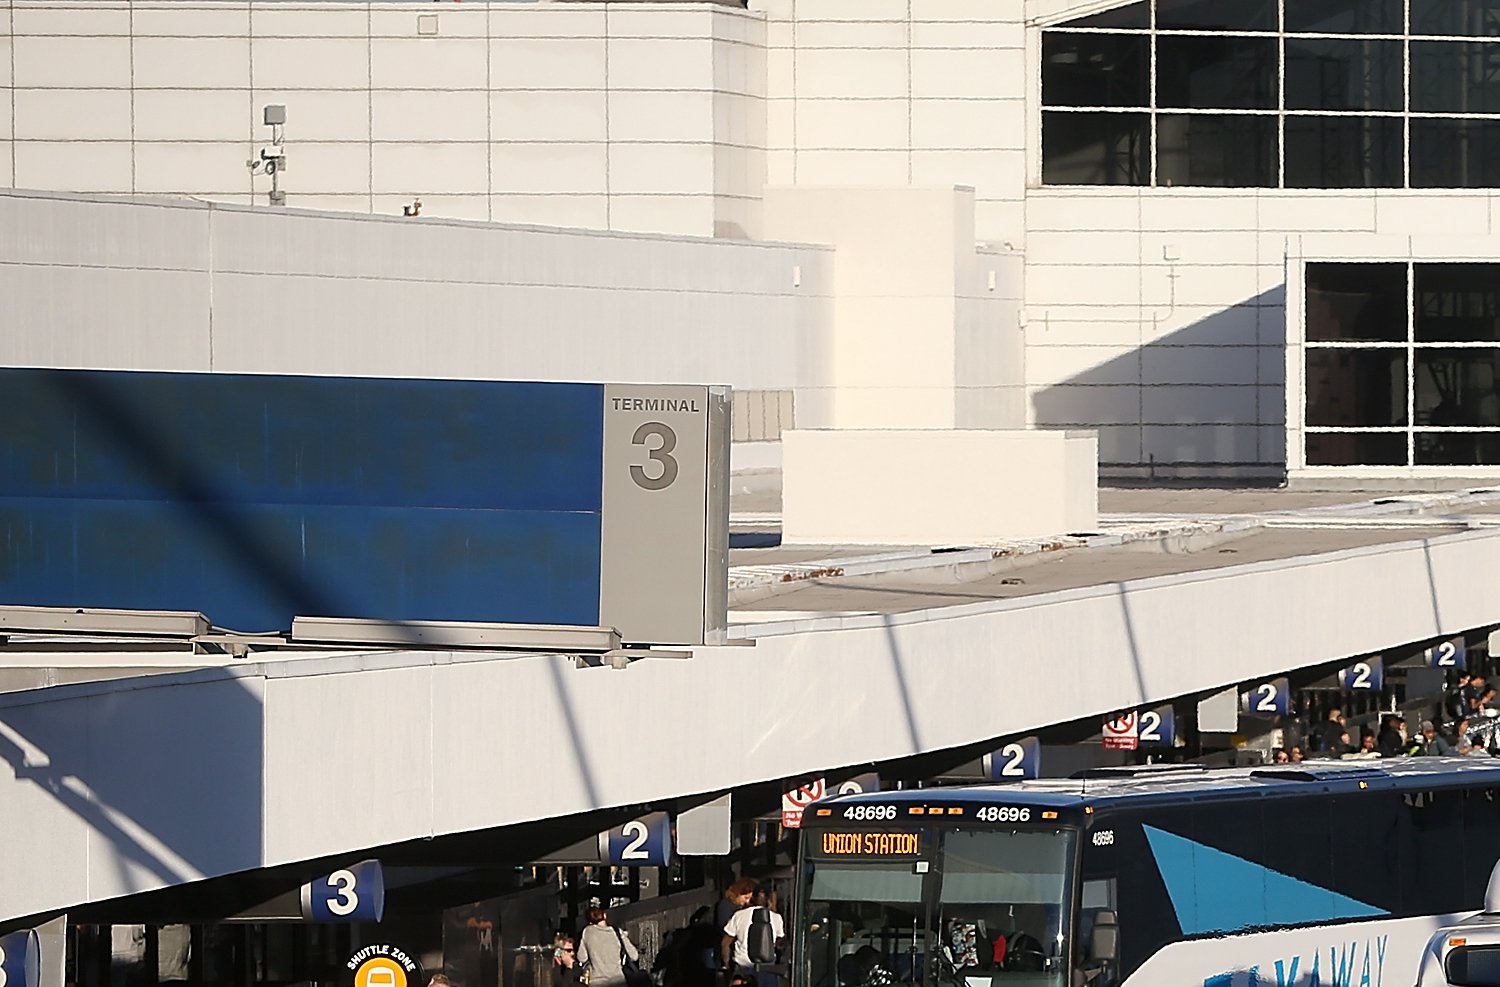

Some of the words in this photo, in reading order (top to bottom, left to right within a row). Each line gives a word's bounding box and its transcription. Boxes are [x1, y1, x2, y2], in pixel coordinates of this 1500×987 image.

[611, 396, 700, 413] TERMINAL
[629, 421, 679, 491] 3
[1438, 641, 1456, 666] 2
[1352, 662, 1372, 689] 2
[1256, 683, 1278, 712] 2
[1139, 711, 1162, 741] 2
[1001, 743, 1025, 776] 2
[843, 805, 897, 821] 48696
[976, 806, 1030, 822] 48696
[621, 820, 649, 860] 2
[823, 833, 862, 854] UNION
[864, 833, 919, 854] STATION
[1092, 830, 1114, 846] 48696
[326, 869, 359, 916] 3
[347, 945, 390, 970] SHUTTLE
[390, 947, 416, 972] ZONE
